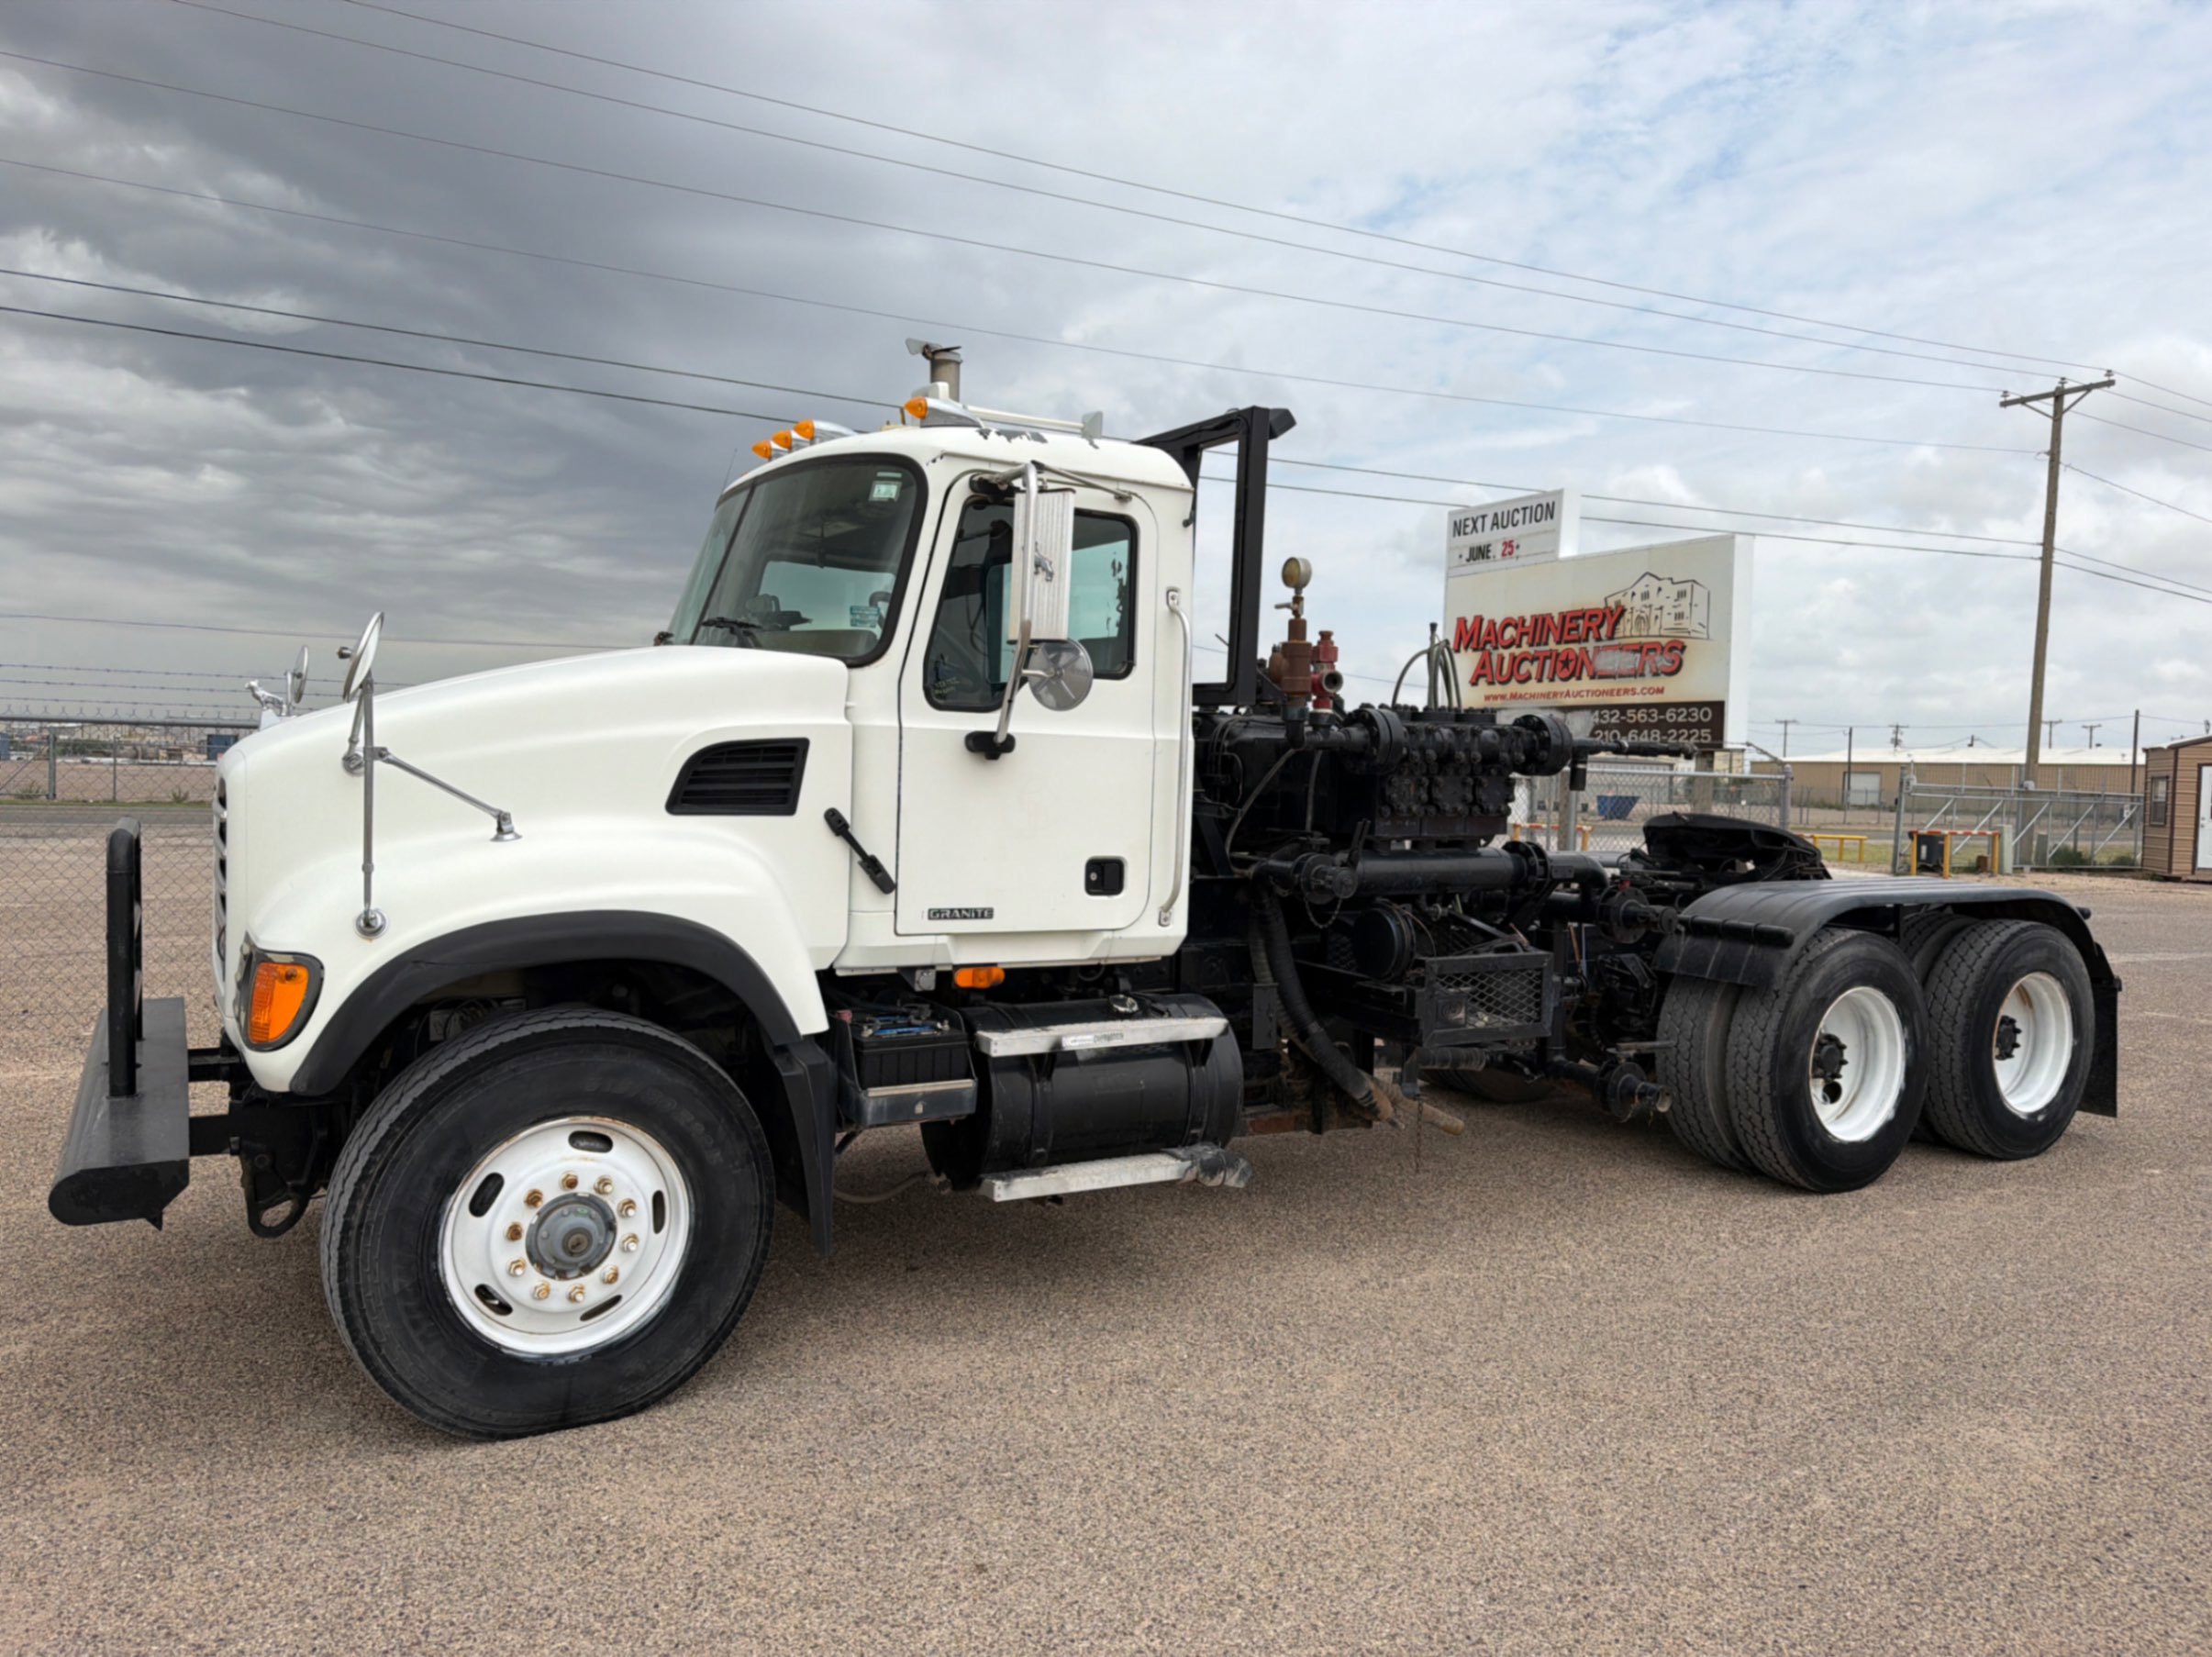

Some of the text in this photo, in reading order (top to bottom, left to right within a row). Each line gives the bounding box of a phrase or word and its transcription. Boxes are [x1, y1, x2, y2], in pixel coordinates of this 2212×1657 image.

[1452, 500, 1555, 538] NEXT AUCTION
[1453, 605, 1626, 653] MACHINERY
[1592, 707, 1713, 724] 432-563-6230
